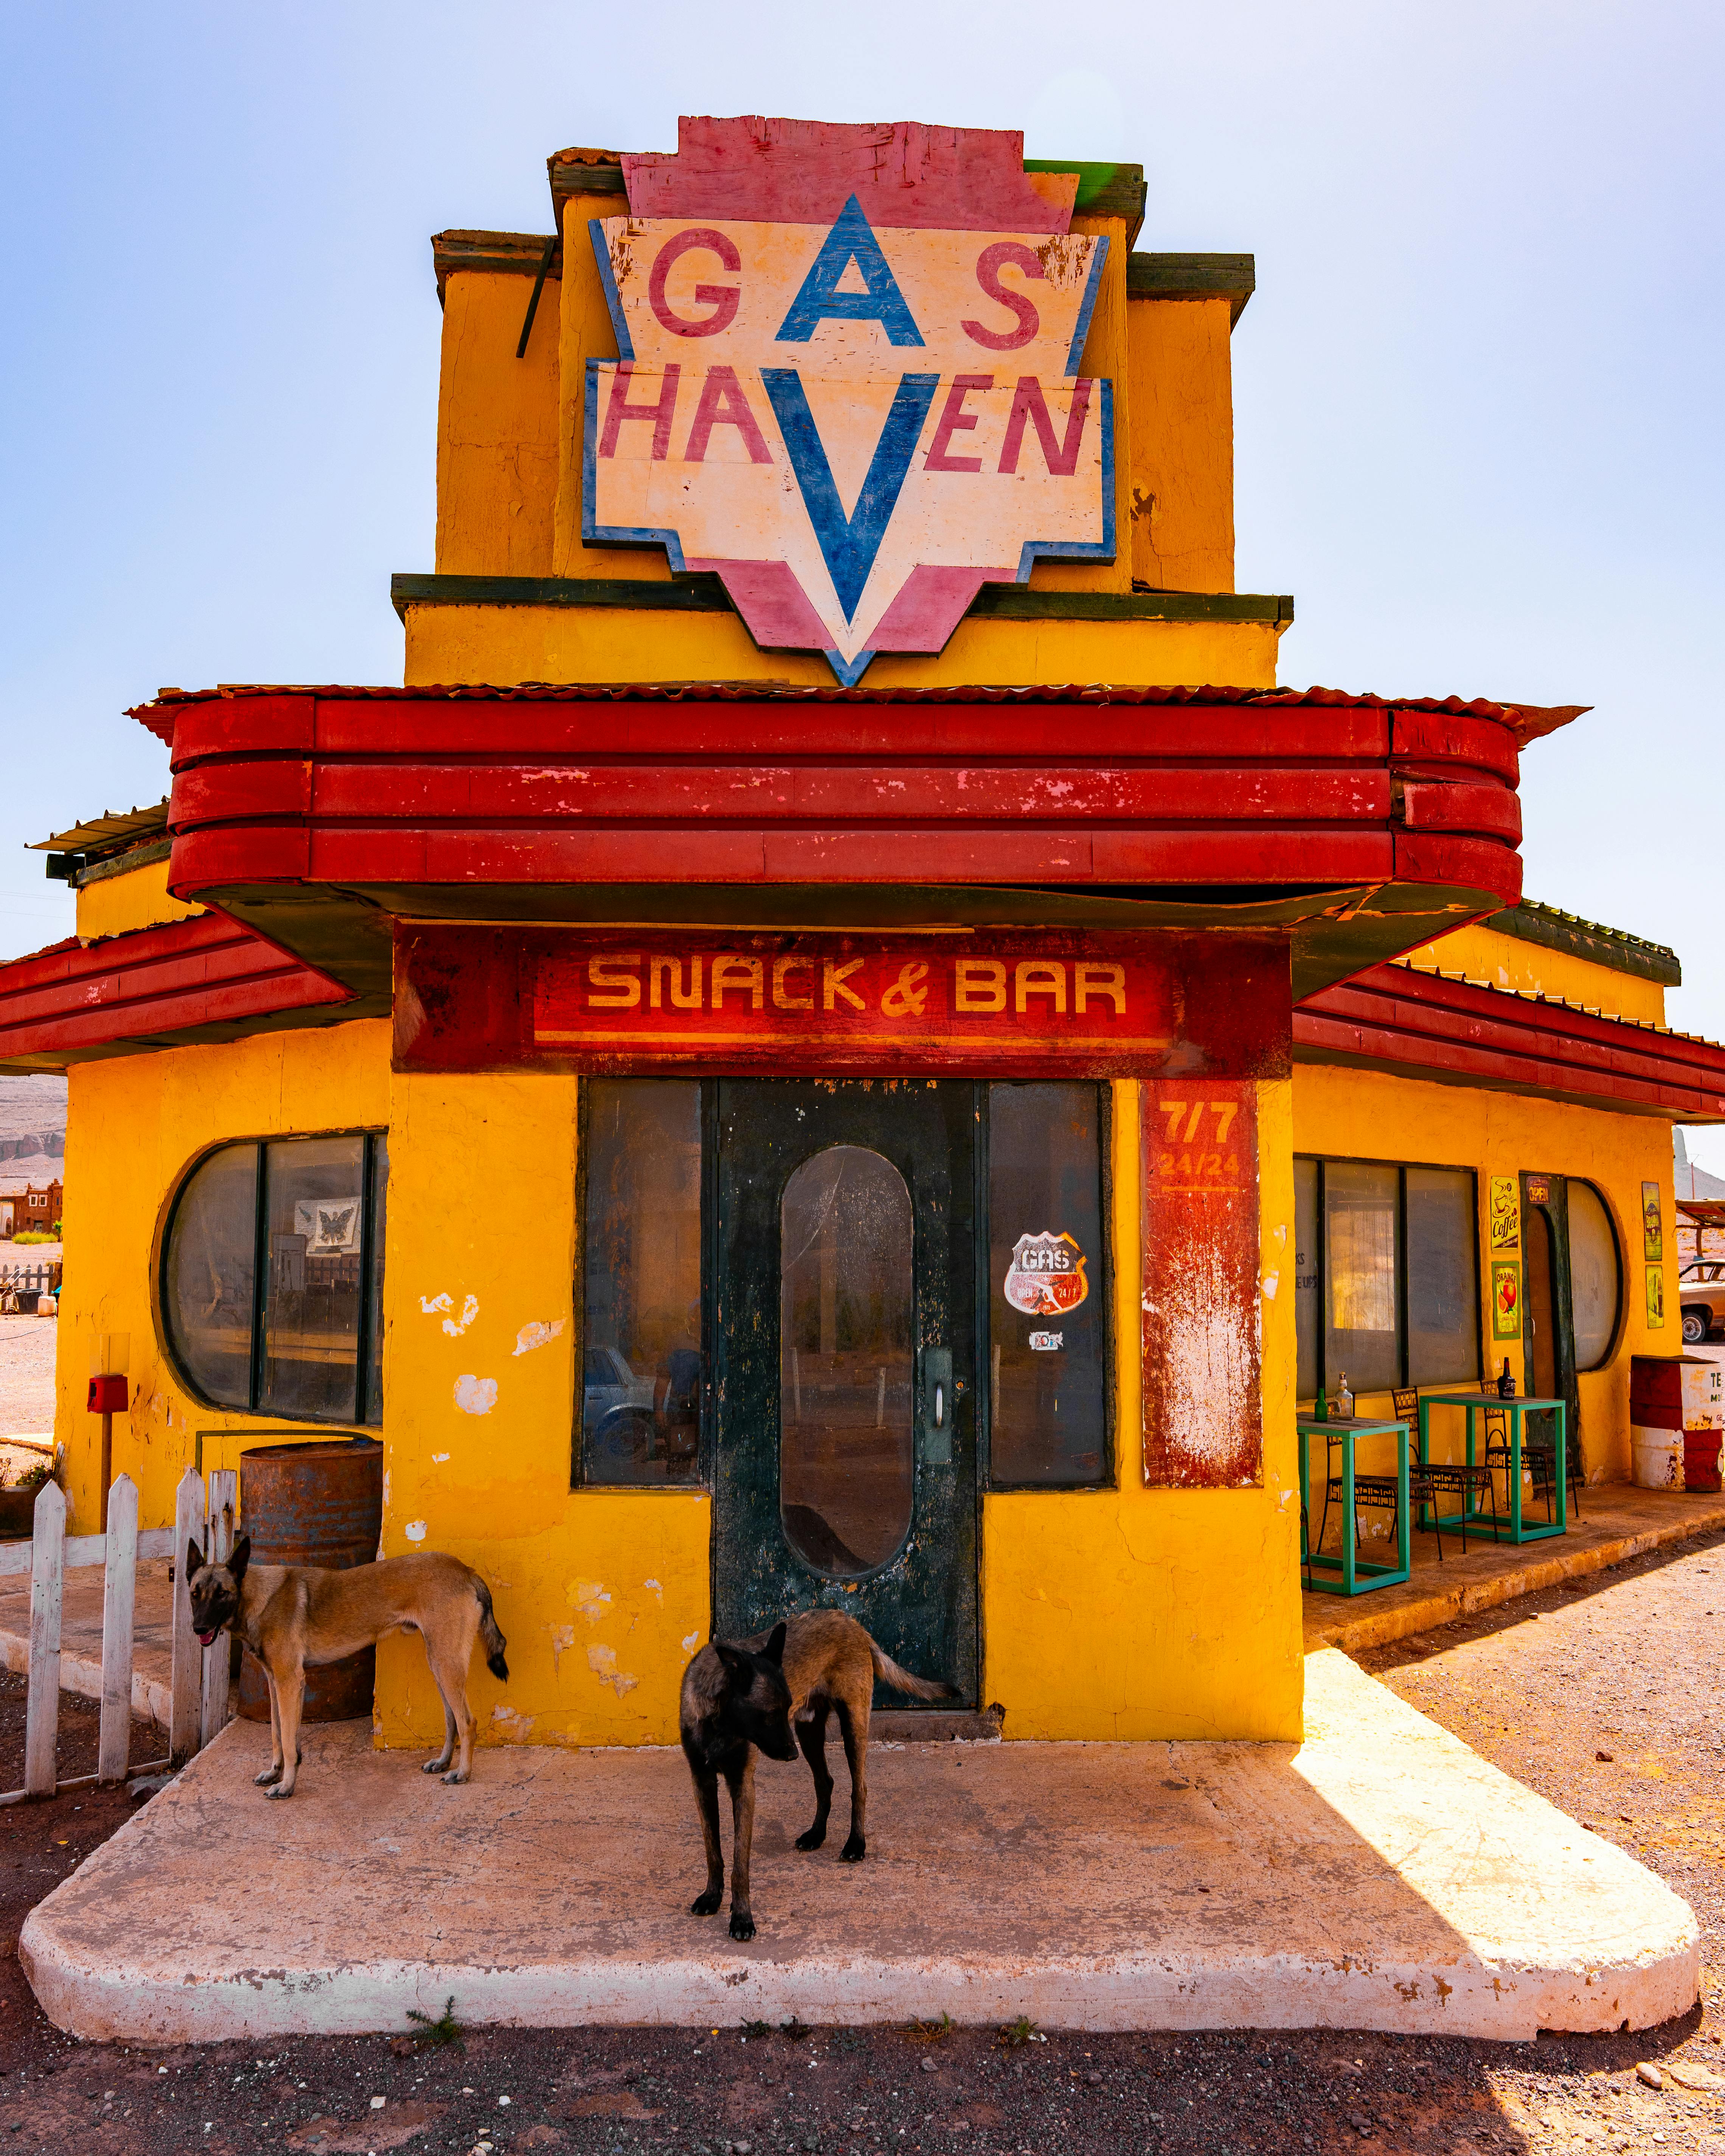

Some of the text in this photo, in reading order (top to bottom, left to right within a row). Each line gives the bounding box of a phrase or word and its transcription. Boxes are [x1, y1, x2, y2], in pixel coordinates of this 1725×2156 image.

[648, 192, 1045, 351] GAS
[598, 362, 1092, 627] HAVEN
[588, 954, 1126, 1017] SNACK & BAR
[1160, 1101, 1238, 1143] 7/7
[1160, 1153, 1239, 1175] 24/24
[1529, 1186, 1548, 1201] OPEN
[1493, 1215, 1518, 1239] Coffee
[1022, 1250, 1070, 1269] GAS
[1497, 1272, 1516, 1283] ORANGE
[1017, 1288, 1033, 1298] OPEN
